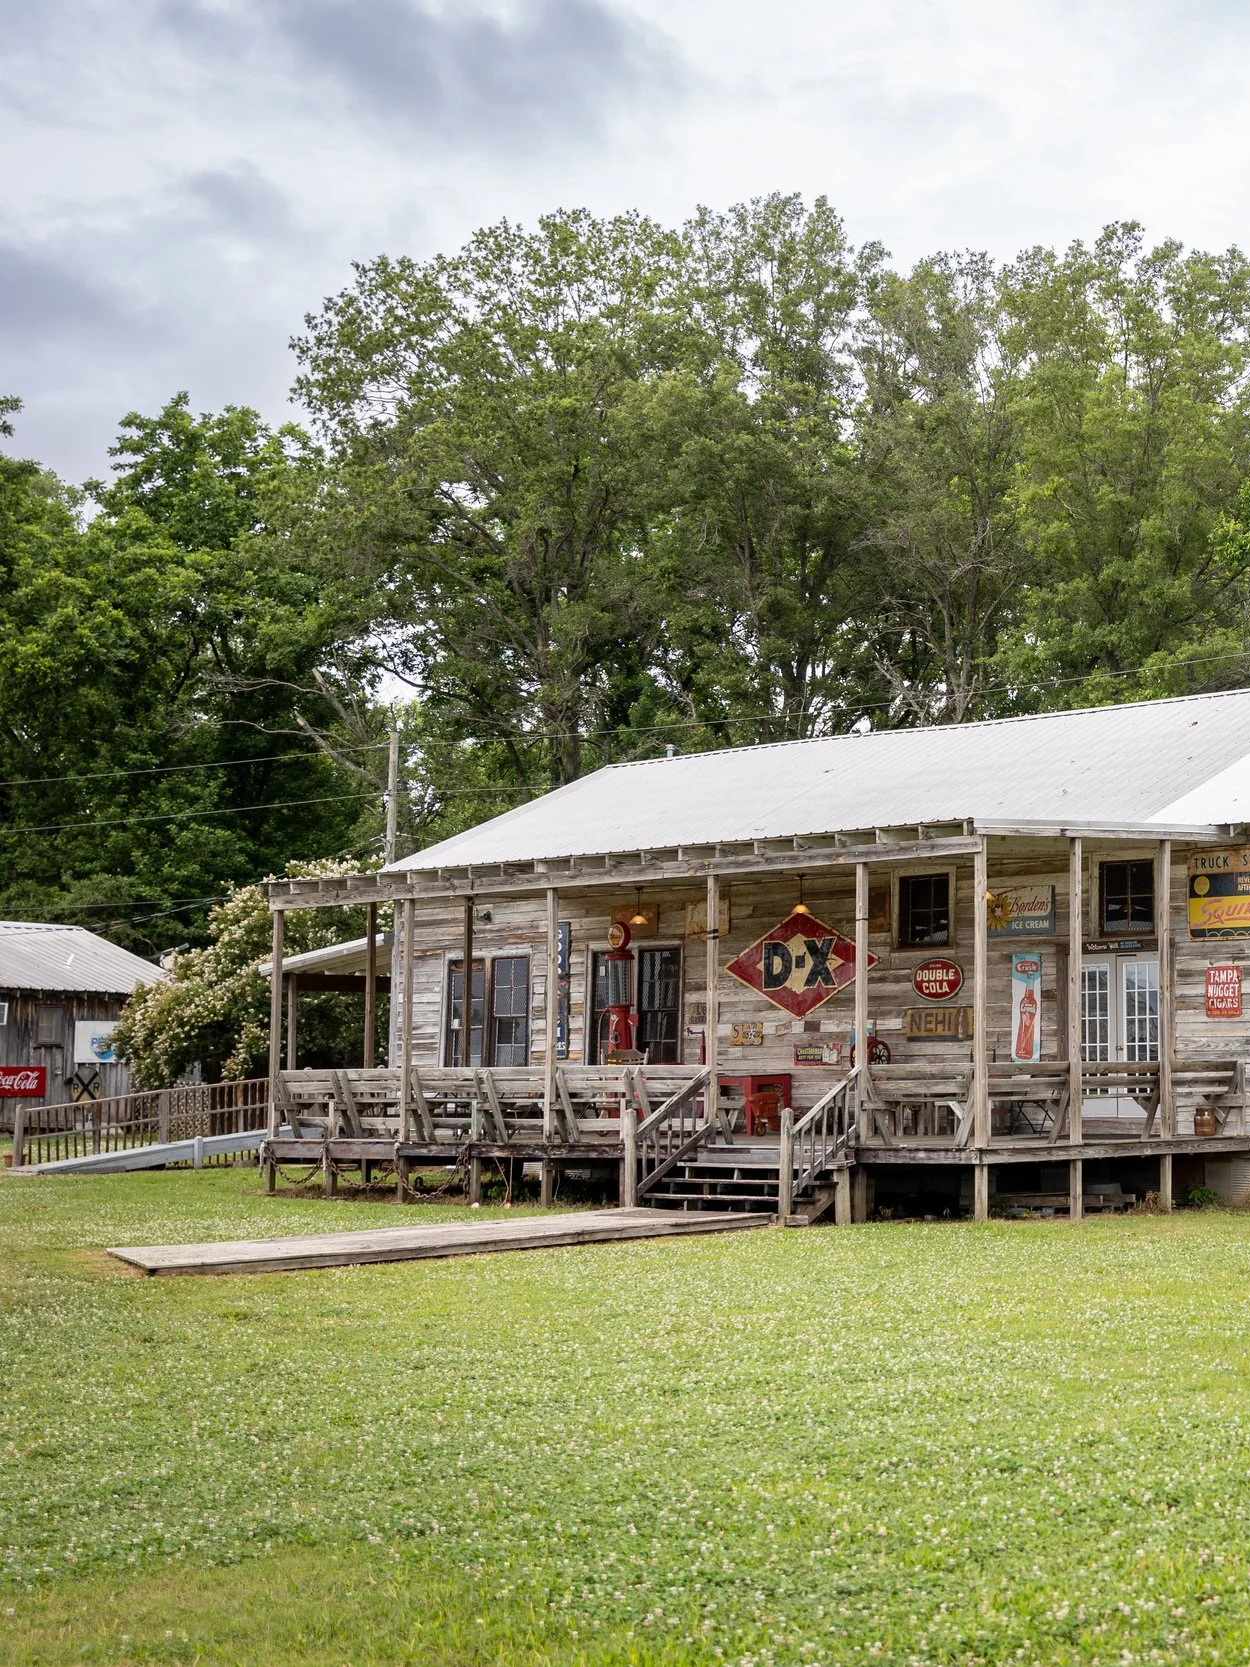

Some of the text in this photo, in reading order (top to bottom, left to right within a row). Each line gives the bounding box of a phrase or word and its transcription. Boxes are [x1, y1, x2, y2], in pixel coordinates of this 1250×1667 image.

[1194, 855, 1230, 869] TRUCK
[1009, 896, 1050, 916] Borden's
[1011, 919, 1050, 930] ICE CREAM
[916, 968, 956, 981] DOUBLE
[1209, 970, 1239, 984] TAMPA
[922, 981, 951, 994] COLA
[1207, 983, 1240, 998] NUGGET
[1208, 998, 1239, 1009] CIGARS
[910, 1010, 953, 1034] NEHI
